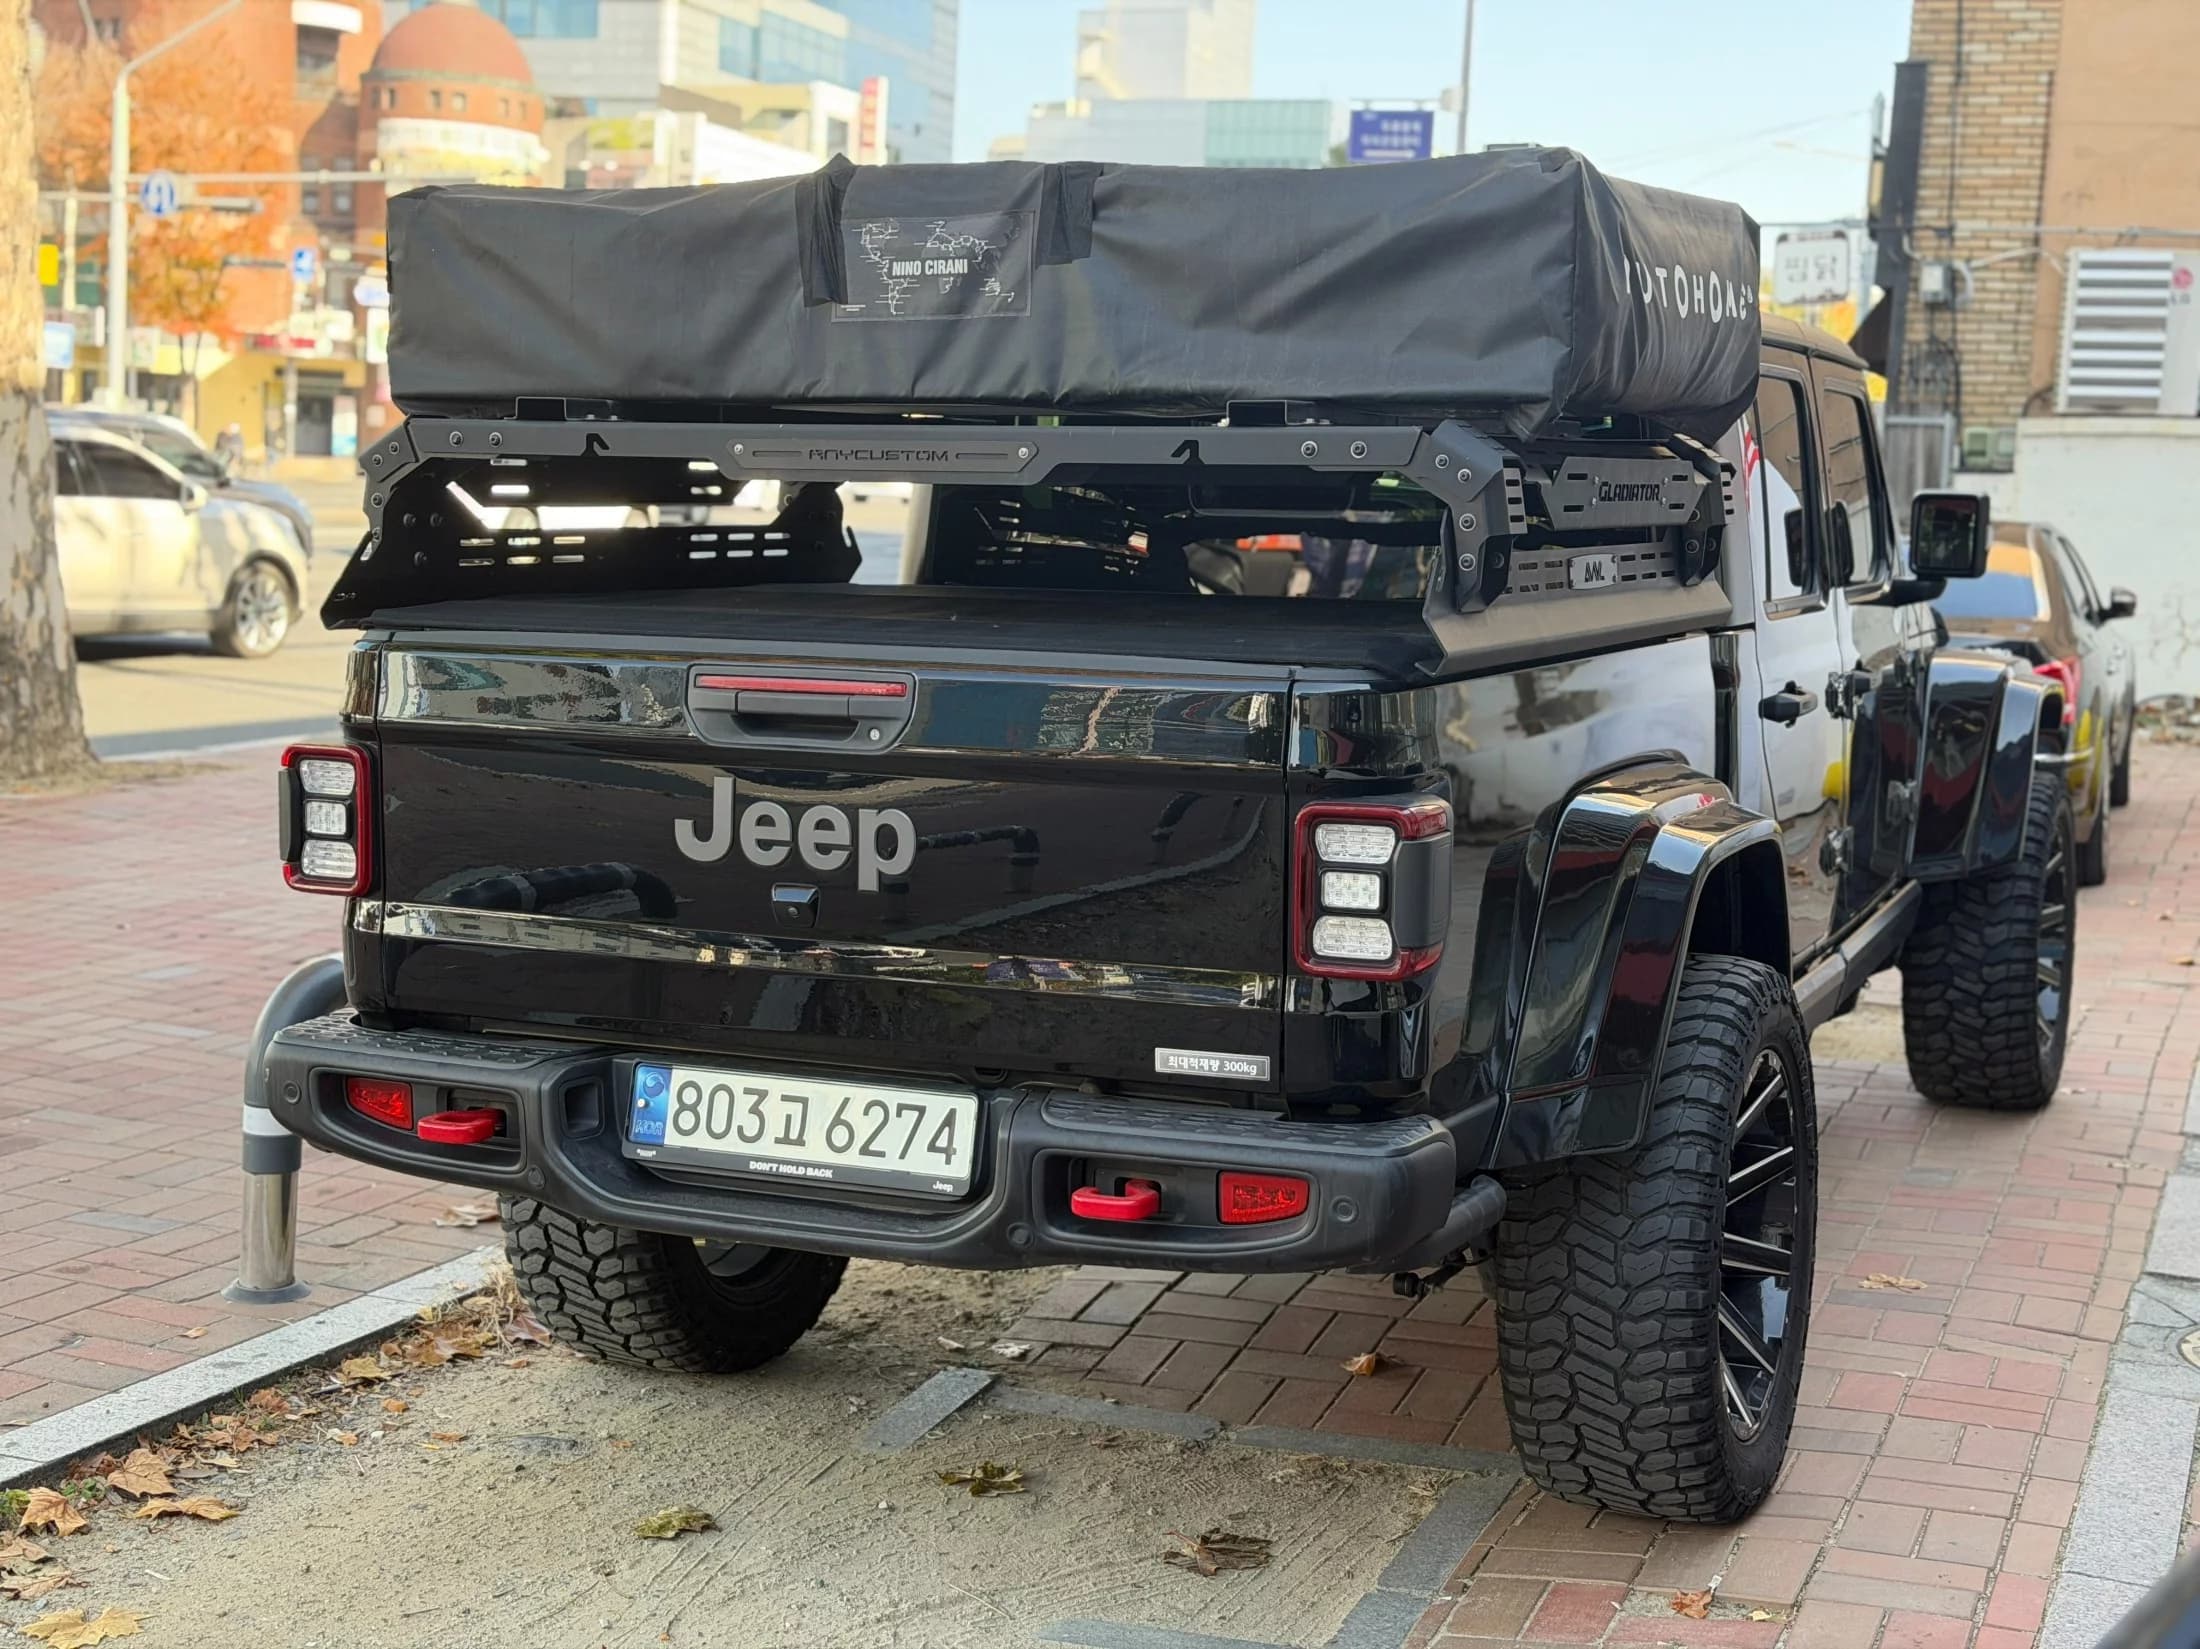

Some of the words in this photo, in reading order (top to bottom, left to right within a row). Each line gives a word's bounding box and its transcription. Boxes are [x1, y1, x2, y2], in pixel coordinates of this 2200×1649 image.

[892, 260, 922, 276] NINO
[925, 258, 969, 275] CIRANI
[808, 448, 949, 462] ANYCUSTOM
[1598, 481, 1661, 502] GLADIATOR
[674, 776, 917, 892] Jeep
[1168, 1055, 1221, 1072] 최대적재량
[1223, 1060, 1257, 1076] 300kg
[825, 1096, 958, 1166] 6274
[749, 1160, 778, 1173] DON'T
[779, 1164, 806, 1176] HOLD
[806, 1167, 833, 1179] BACK
[932, 1180, 954, 1193] Jeep
